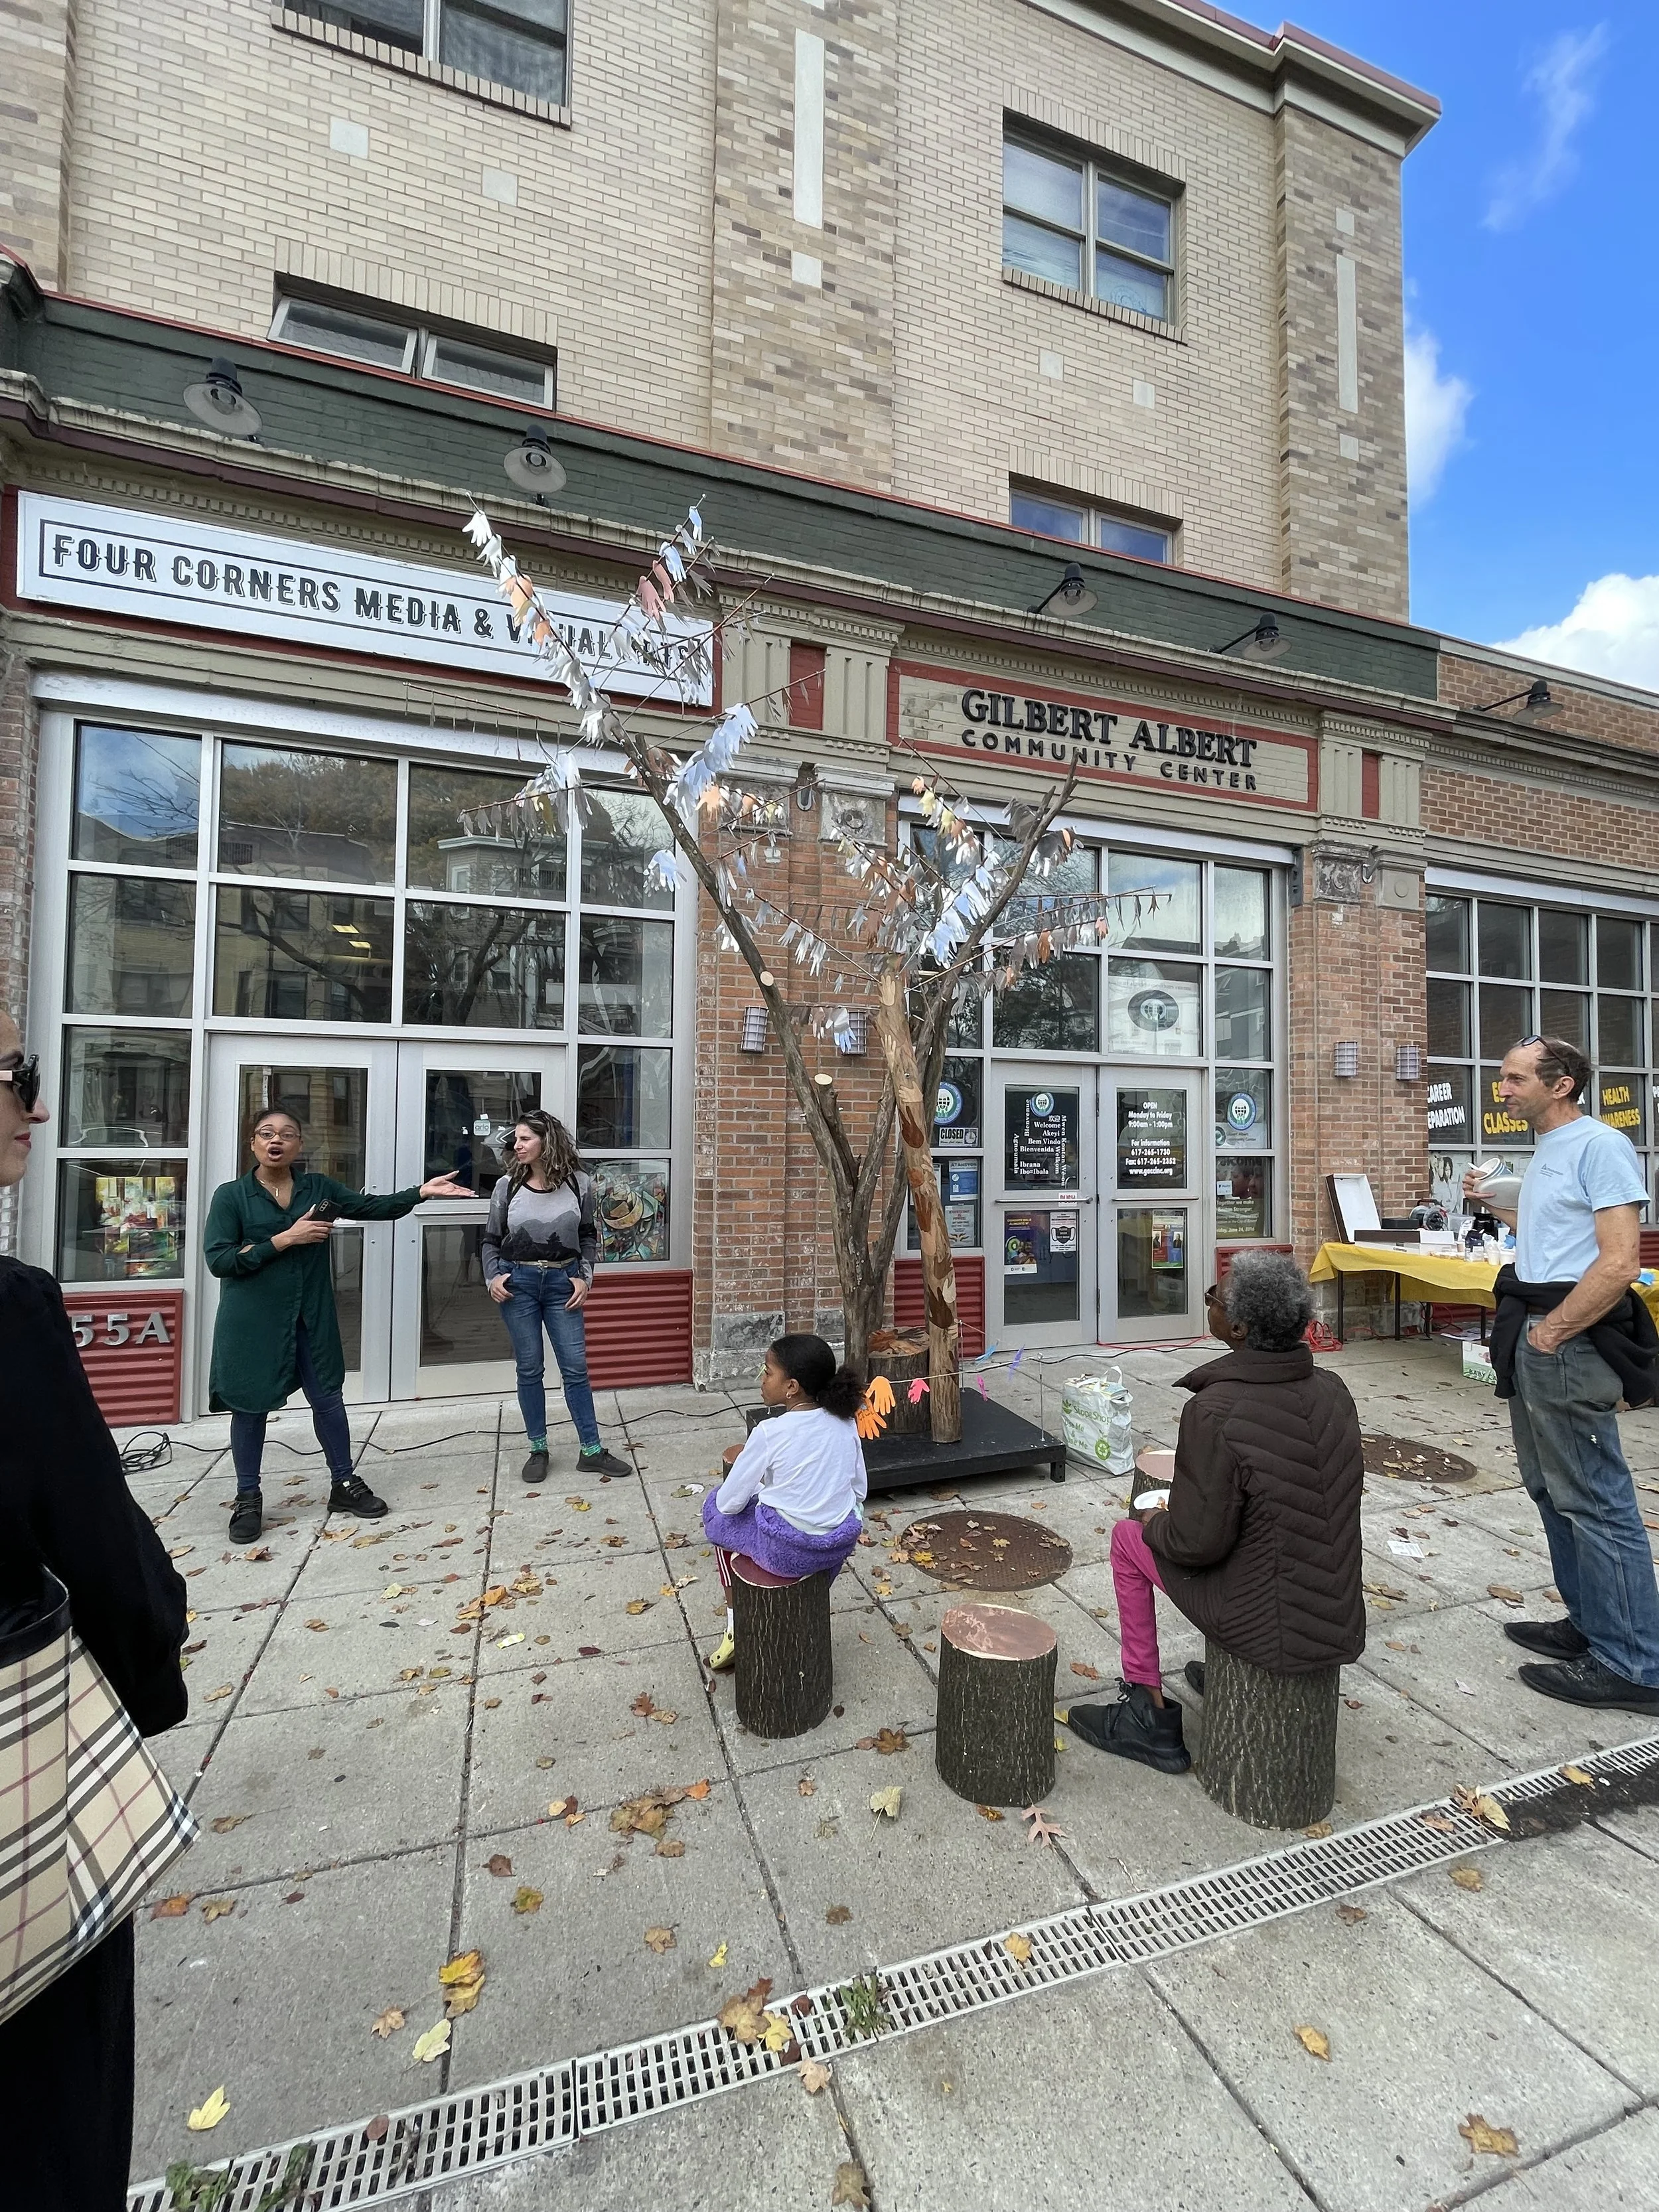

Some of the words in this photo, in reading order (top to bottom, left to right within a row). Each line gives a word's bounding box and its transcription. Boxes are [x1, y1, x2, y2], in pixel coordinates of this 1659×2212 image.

[53, 534, 156, 582] FOUR
[171, 555, 341, 613] CORNERS
[354, 587, 461, 634] MEDIA
[474, 608, 494, 639] &
[506, 613, 613, 660] VUAL
[962, 688, 1118, 745] GILBERT
[1129, 720, 1257, 768] ALBERT
[962, 729, 1136, 771] COMMUNITY
[1160, 761, 1257, 790] CENTER
[1602, 1086, 1630, 1106] HEALTH
[1128, 1111, 1149, 1120] Monday
[1156, 1111, 1173, 1120] Friday
[1153, 1120, 1173, 1130] 1:00pm
[1483, 1112, 1528, 1134] CLASSES
[940, 1128, 964, 1140] CLOSED
[1469, 1368, 1486, 1378] BABY
[1073, 1405, 1112, 1426] Stop&Shop
